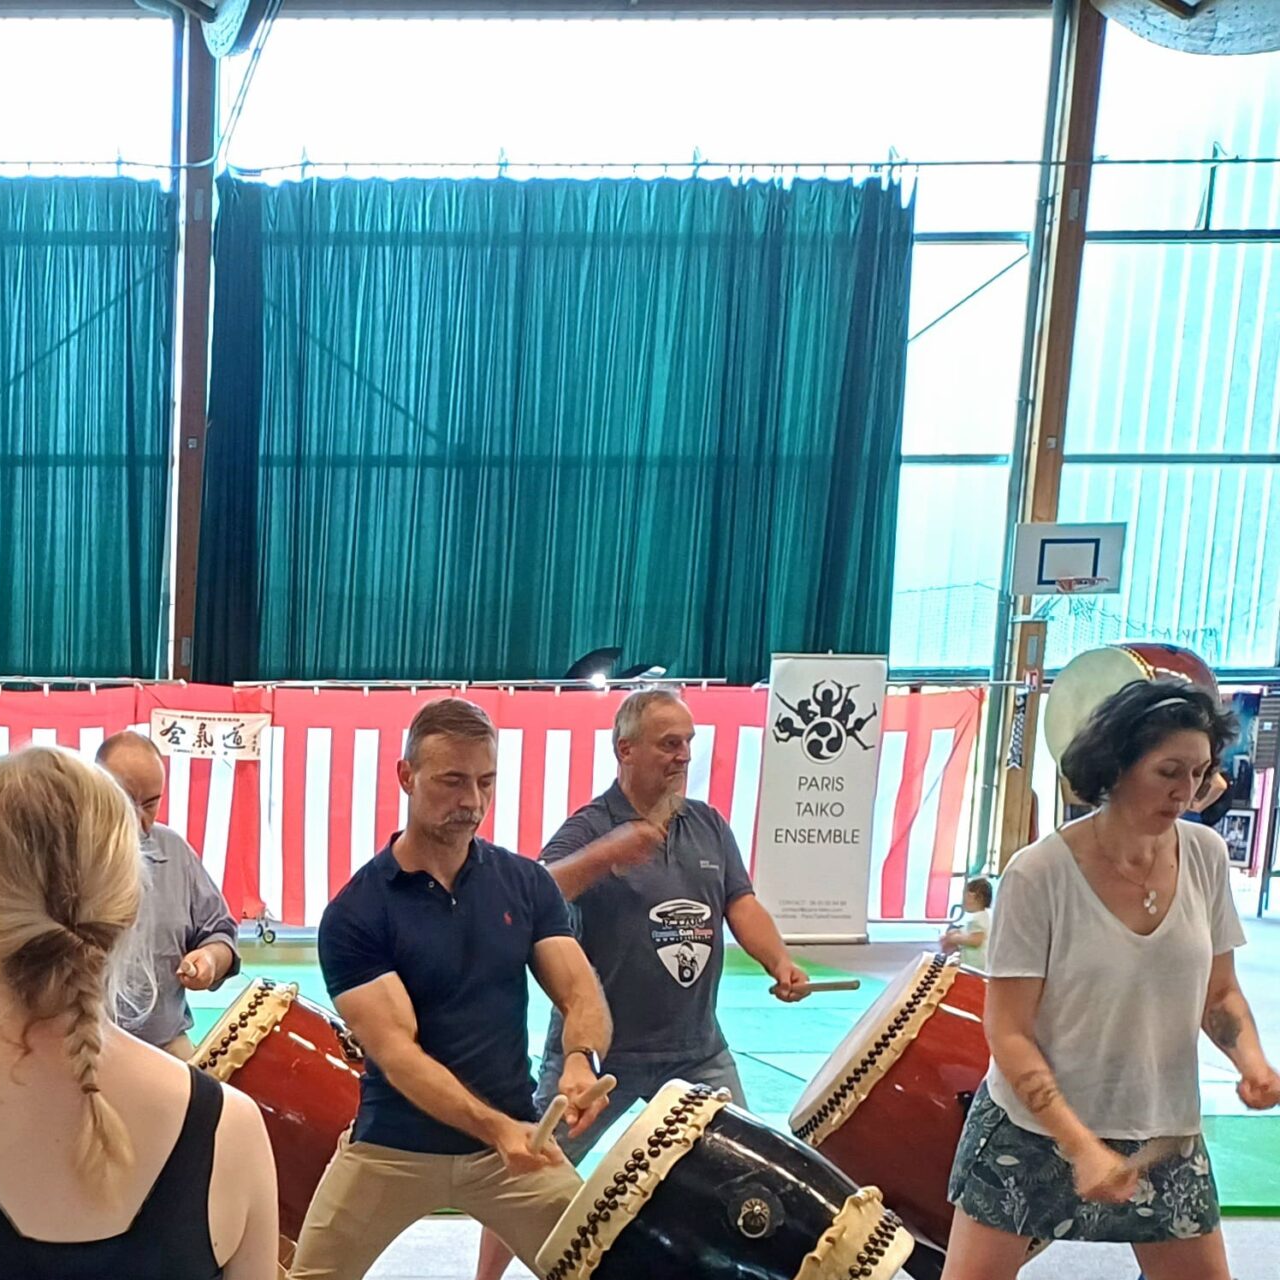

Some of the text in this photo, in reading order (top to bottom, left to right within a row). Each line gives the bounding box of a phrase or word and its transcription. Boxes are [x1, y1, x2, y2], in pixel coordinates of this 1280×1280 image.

[798, 776, 845, 792] PARIS
[795, 802, 845, 818] TAIKO
[774, 828, 860, 844] ENSEMBLE
